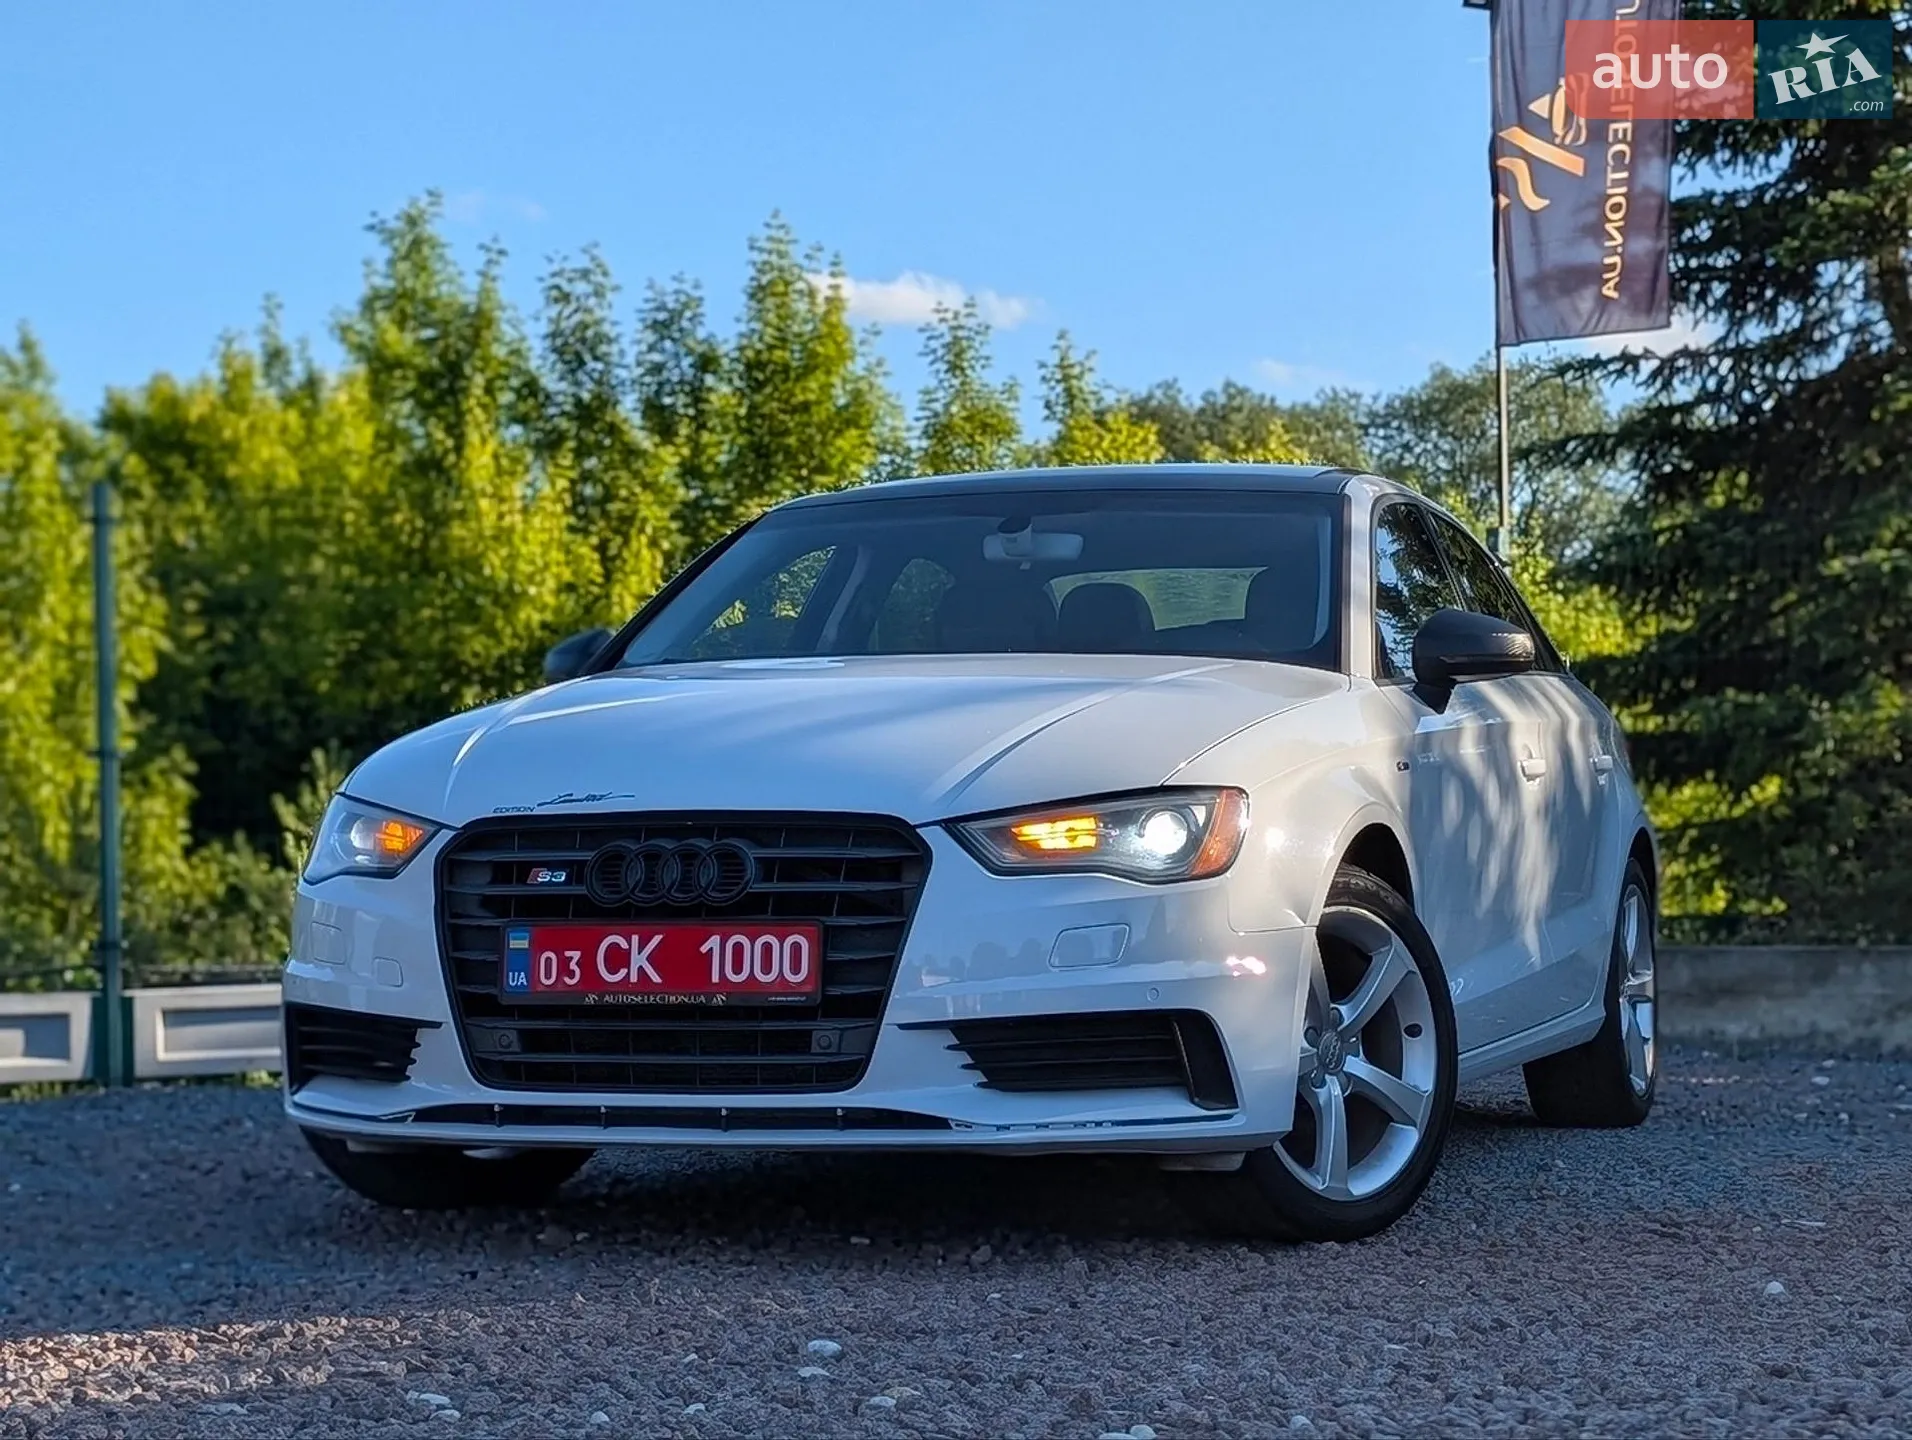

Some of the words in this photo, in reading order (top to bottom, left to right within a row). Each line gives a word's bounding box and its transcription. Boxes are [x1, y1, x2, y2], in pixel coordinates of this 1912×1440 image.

[493, 806, 536, 814] EDITION
[536, 870, 567, 883] S3
[539, 950, 582, 985] 03
[596, 934, 664, 983] CK
[699, 934, 809, 983] 1000
[509, 971, 528, 986] UA
[603, 993, 707, 1005] AUTOSELECTION.UA
